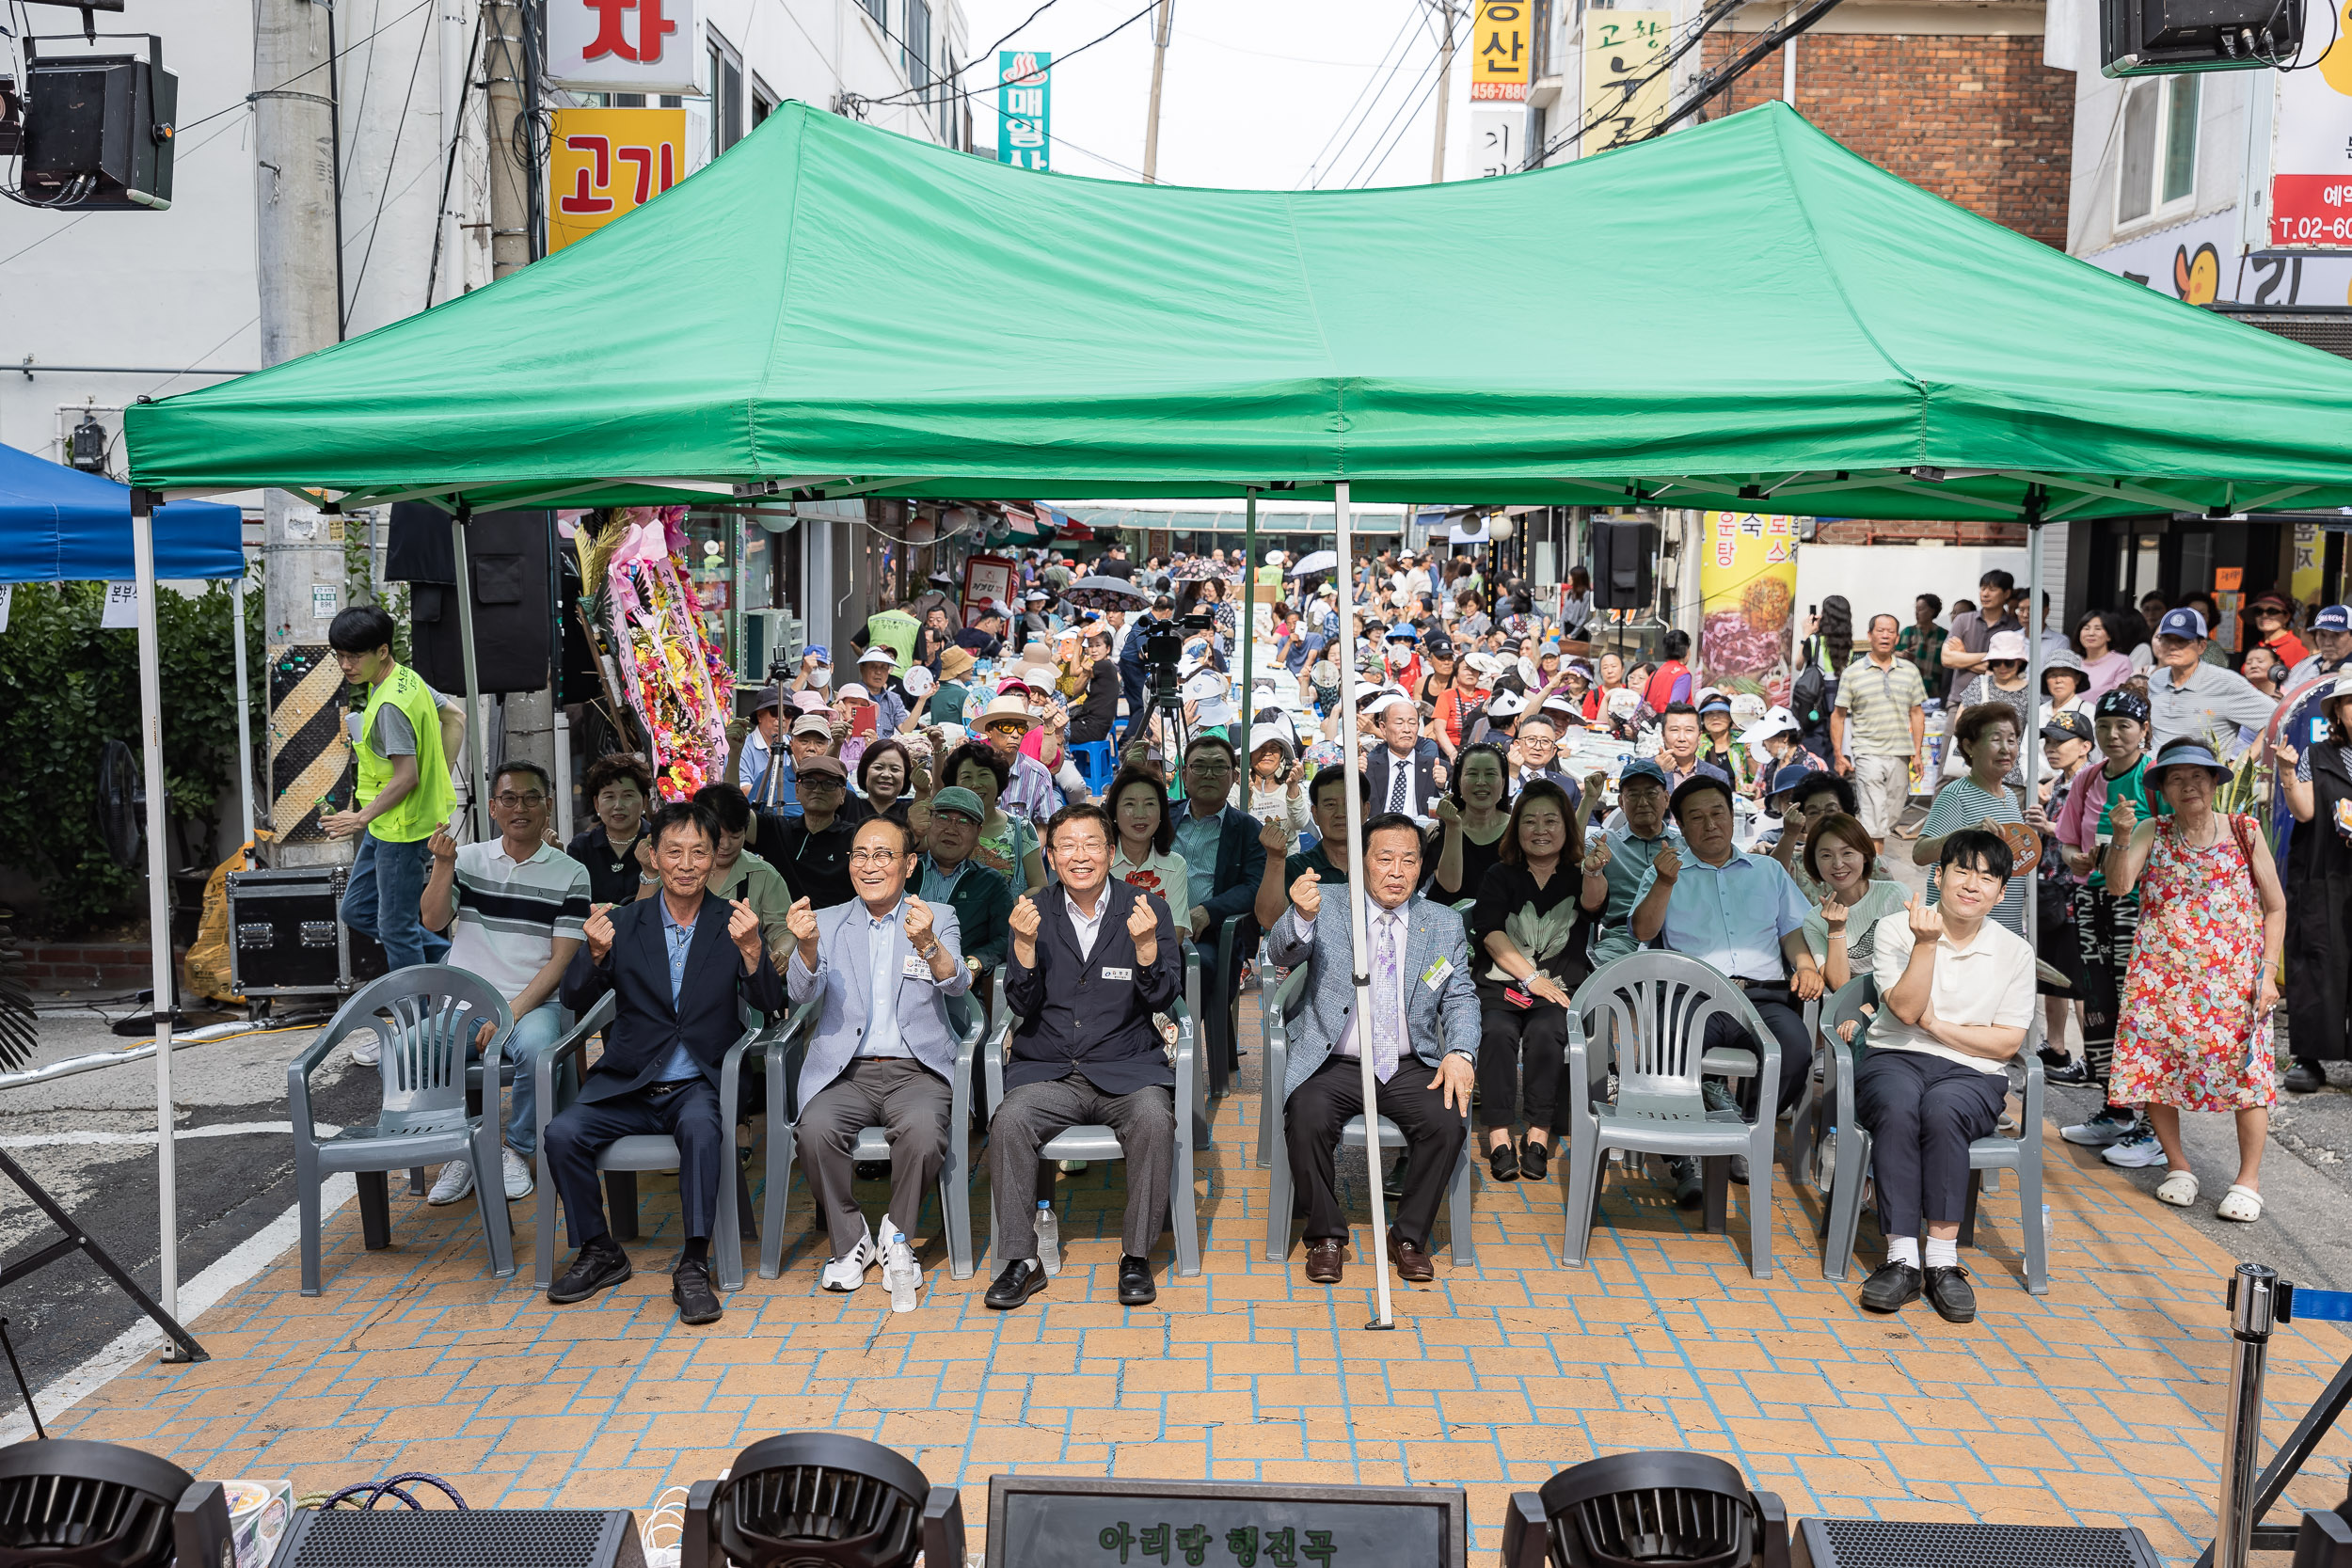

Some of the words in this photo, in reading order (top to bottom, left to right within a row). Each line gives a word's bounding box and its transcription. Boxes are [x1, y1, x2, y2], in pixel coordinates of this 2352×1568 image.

[1598, 20, 1663, 49] 고향
[561, 134, 675, 214] 고기
[1098, 1521, 1212, 1566] 아리랑
[1225, 1525, 1337, 1568] 행진곡
